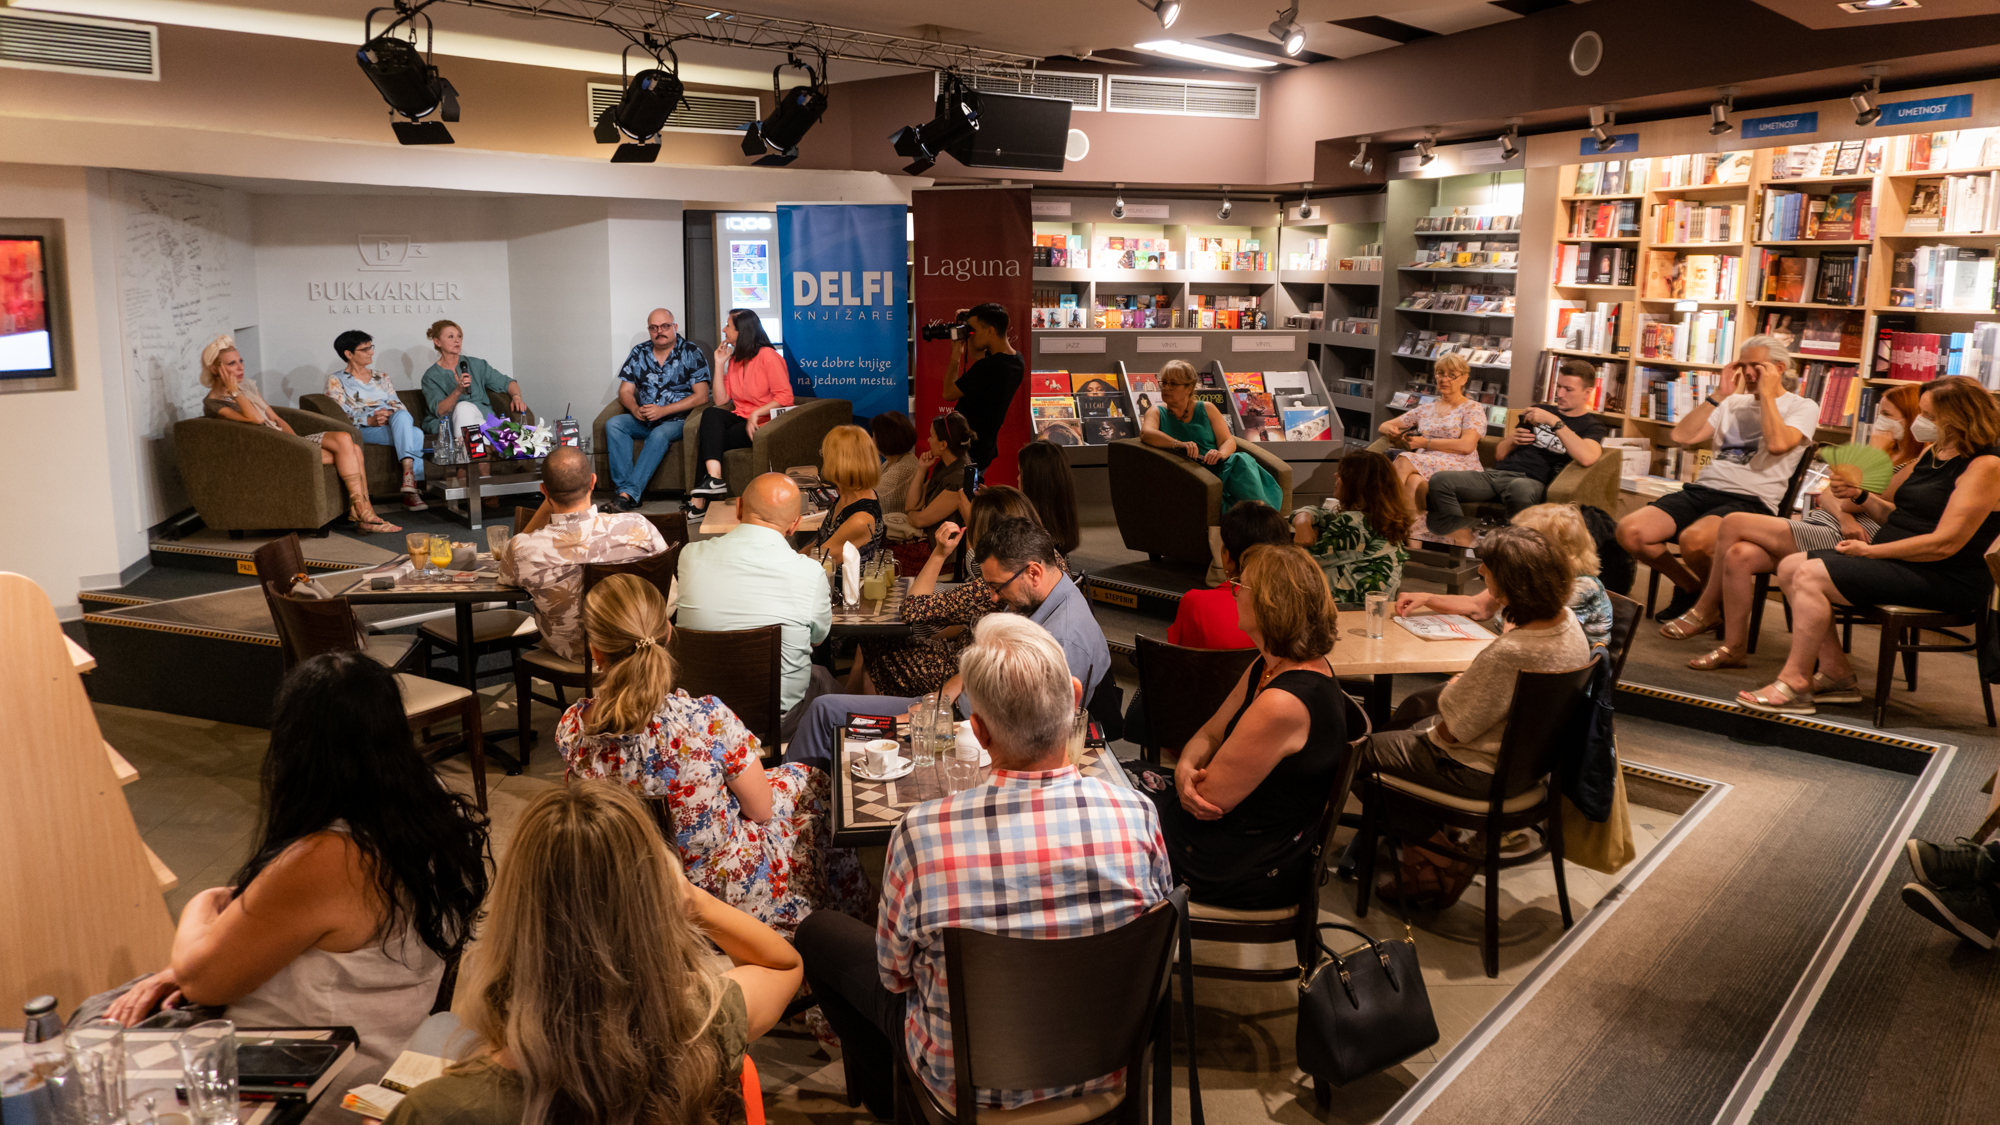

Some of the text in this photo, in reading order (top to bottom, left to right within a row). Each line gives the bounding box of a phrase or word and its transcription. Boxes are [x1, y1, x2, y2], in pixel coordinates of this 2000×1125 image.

[1898, 103, 1948, 117] UMETNOST
[1759, 119, 1799, 131] UMETNOST
[726, 217, 772, 231] IQOS
[923, 256, 1021, 282] Laguna
[308, 281, 461, 301] BUKMARKER
[793, 271, 893, 306] DELFI
[328, 304, 445, 314] KAFETERIJA
[794, 308, 893, 320] KNJIŽARE
[800, 356, 892, 372] Sve dobre knjige
[797, 373, 896, 388] na jednom mestu.
[1105, 592, 1134, 604] STEPENIK
